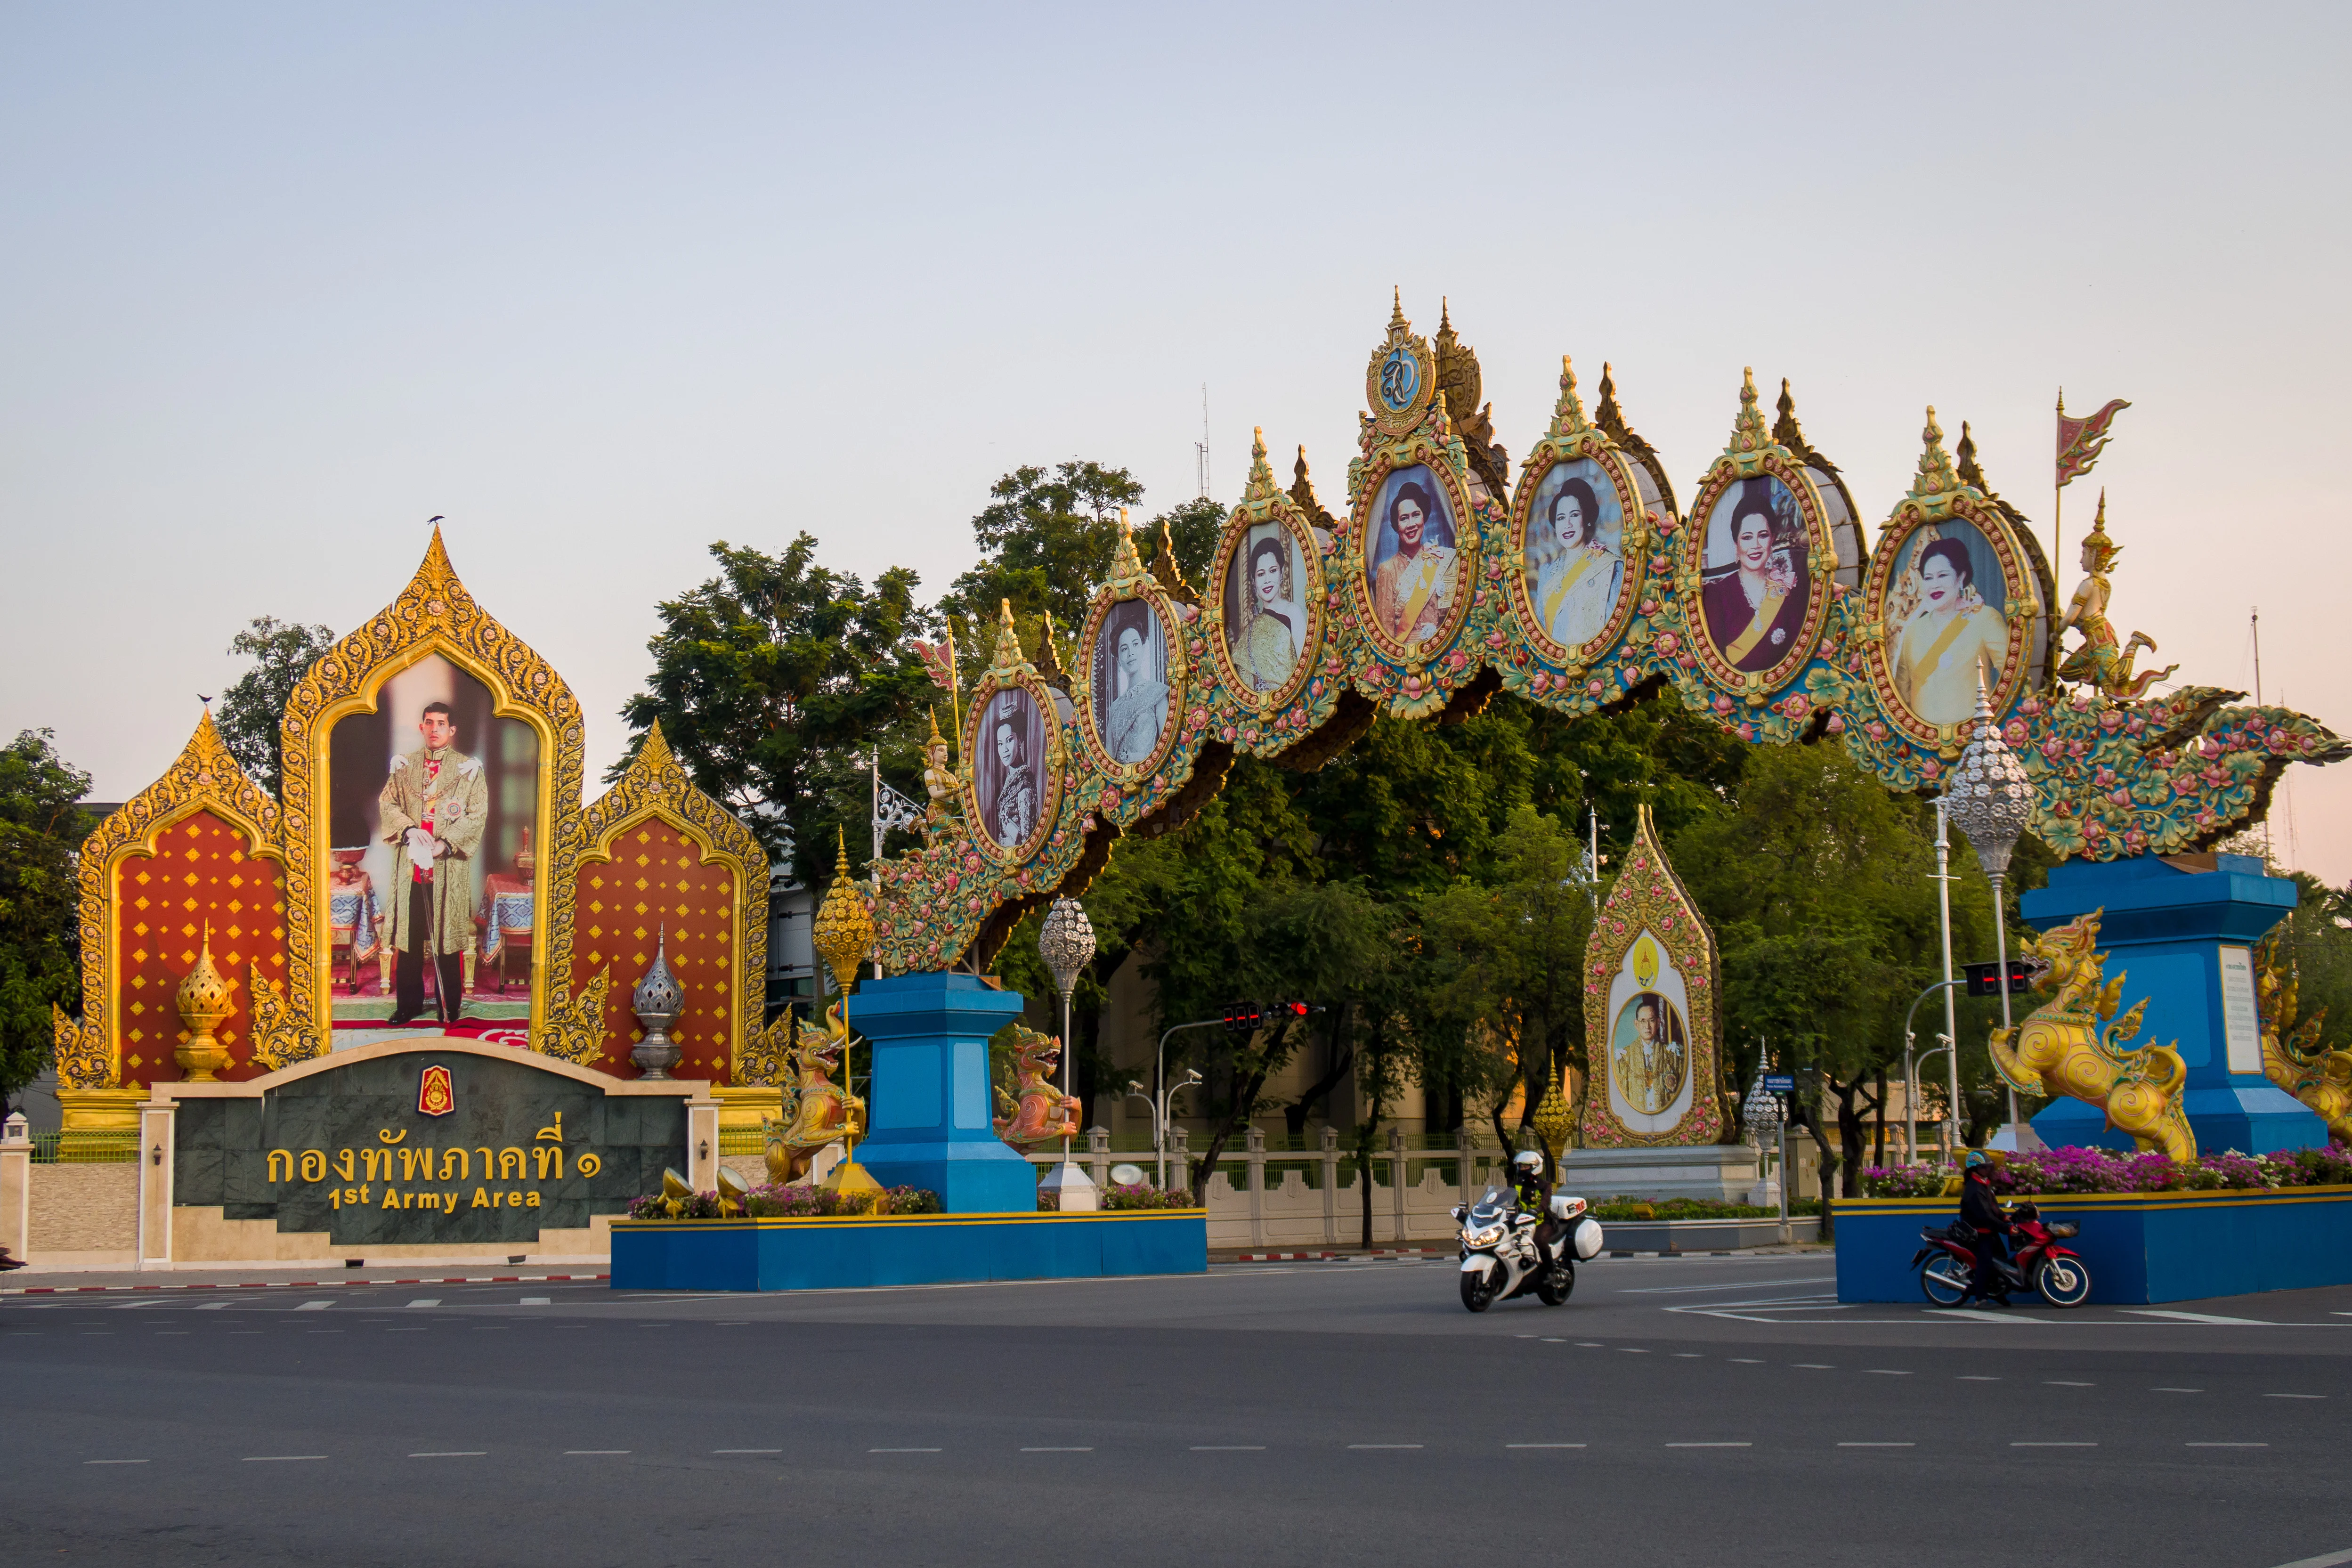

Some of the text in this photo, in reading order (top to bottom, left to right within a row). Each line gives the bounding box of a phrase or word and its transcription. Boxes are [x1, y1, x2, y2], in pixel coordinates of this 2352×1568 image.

[267, 1112, 601, 1182] กองทัพภาคที่ ๑
[329, 1183, 541, 1214] 1st Army Area
